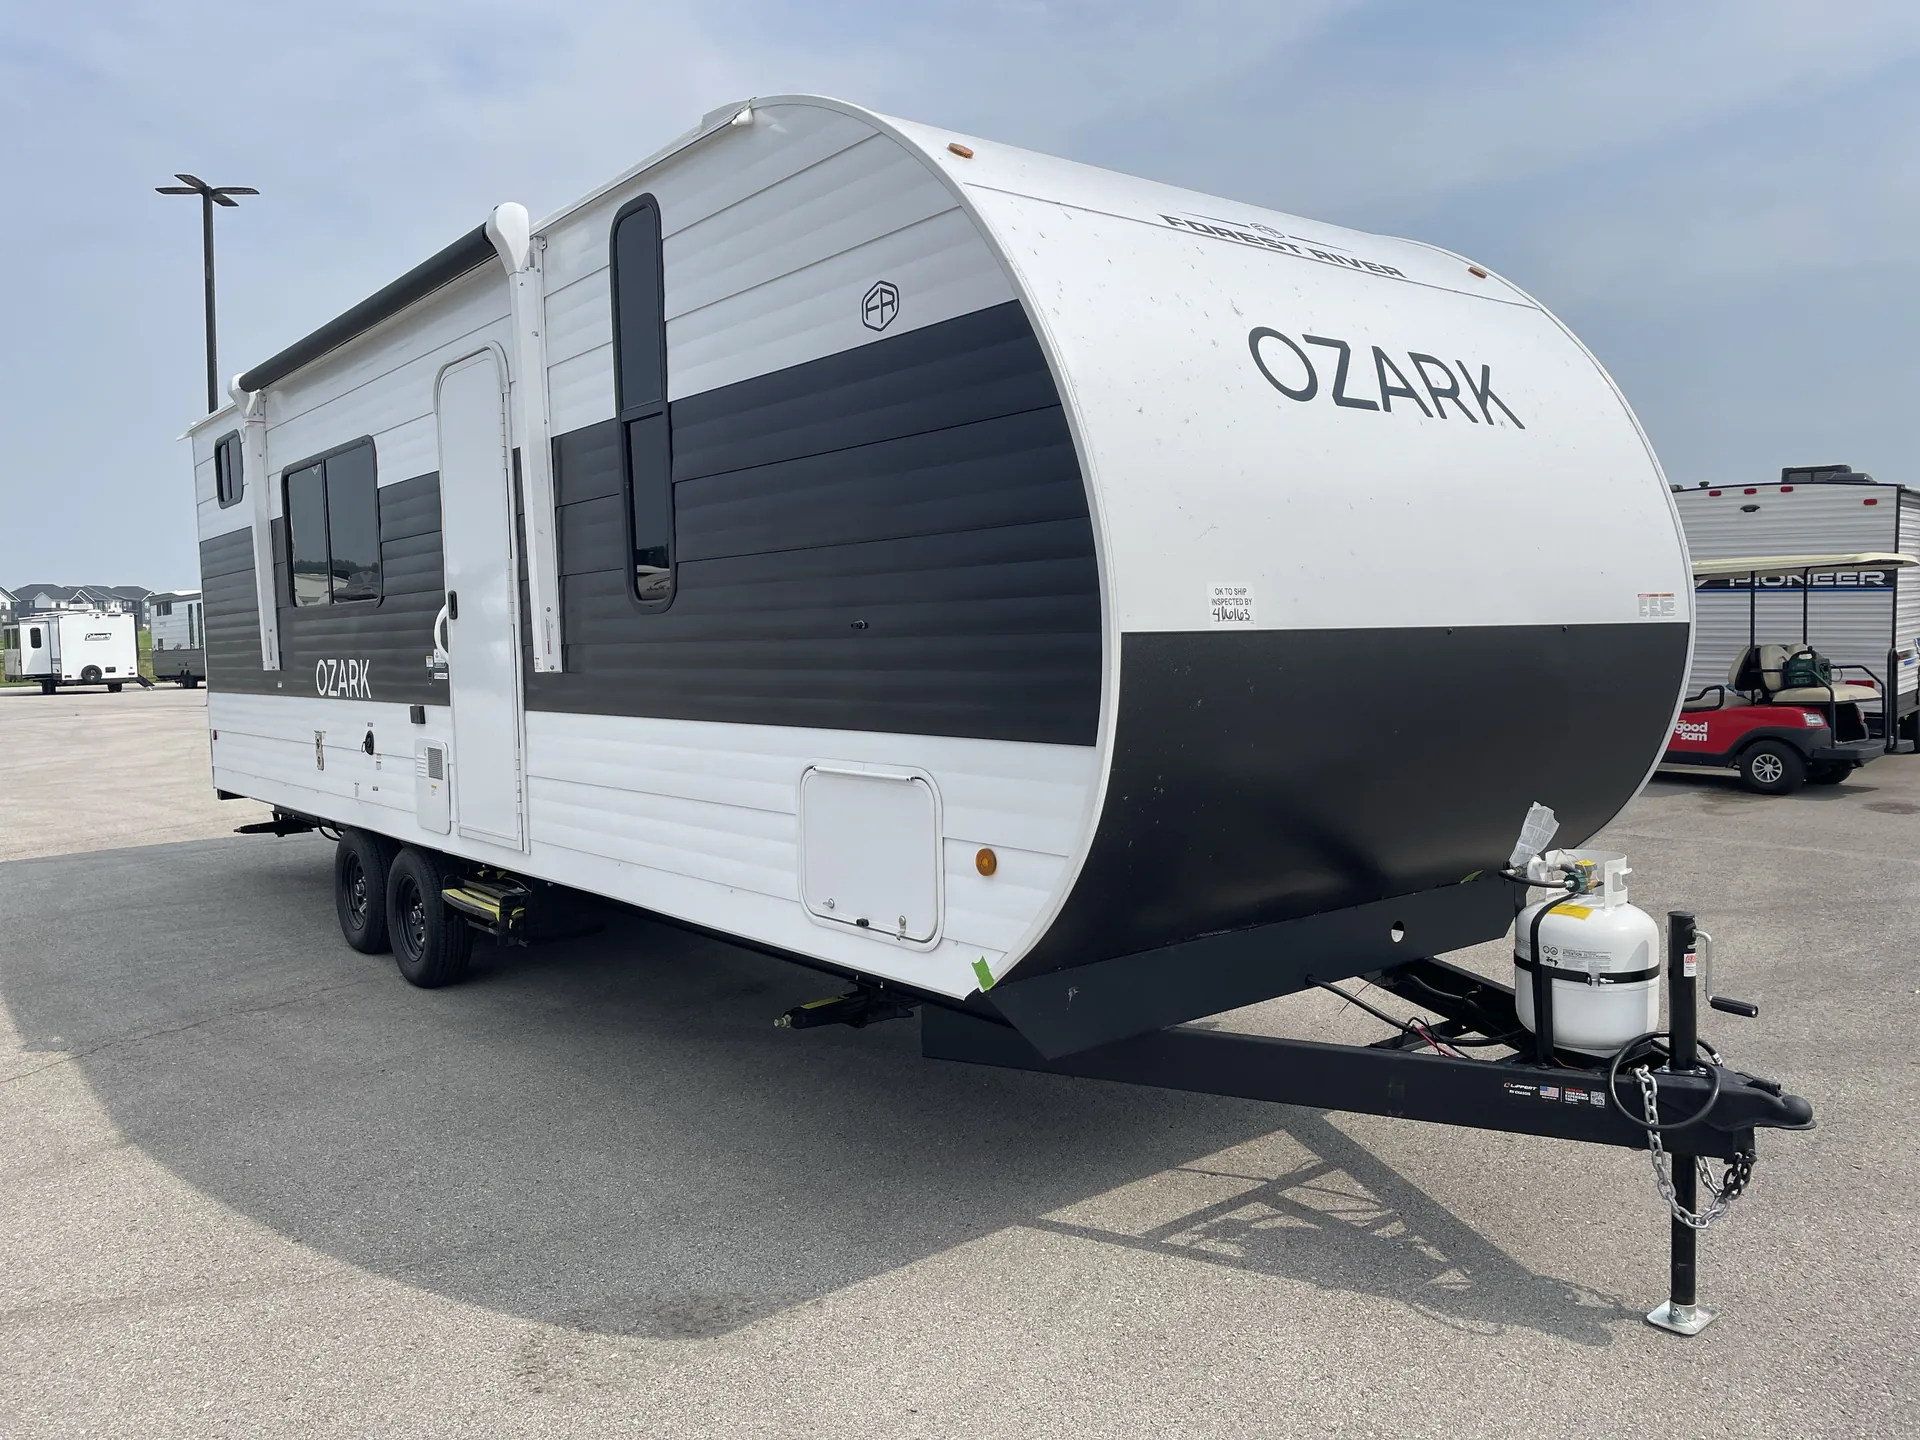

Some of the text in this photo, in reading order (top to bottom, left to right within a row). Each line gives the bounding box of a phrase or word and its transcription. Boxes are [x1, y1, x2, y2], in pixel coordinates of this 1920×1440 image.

[1157, 213, 1302, 254] FOREST
[1305, 247, 1407, 278] RIVER
[865, 287, 896, 325] FR
[1248, 326, 1526, 430] OZARK
[1211, 597, 1252, 605] INSPECTED BY
[316, 659, 371, 699] OZARK
[1675, 721, 1708, 734] good
[1681, 732, 1708, 741] sam
